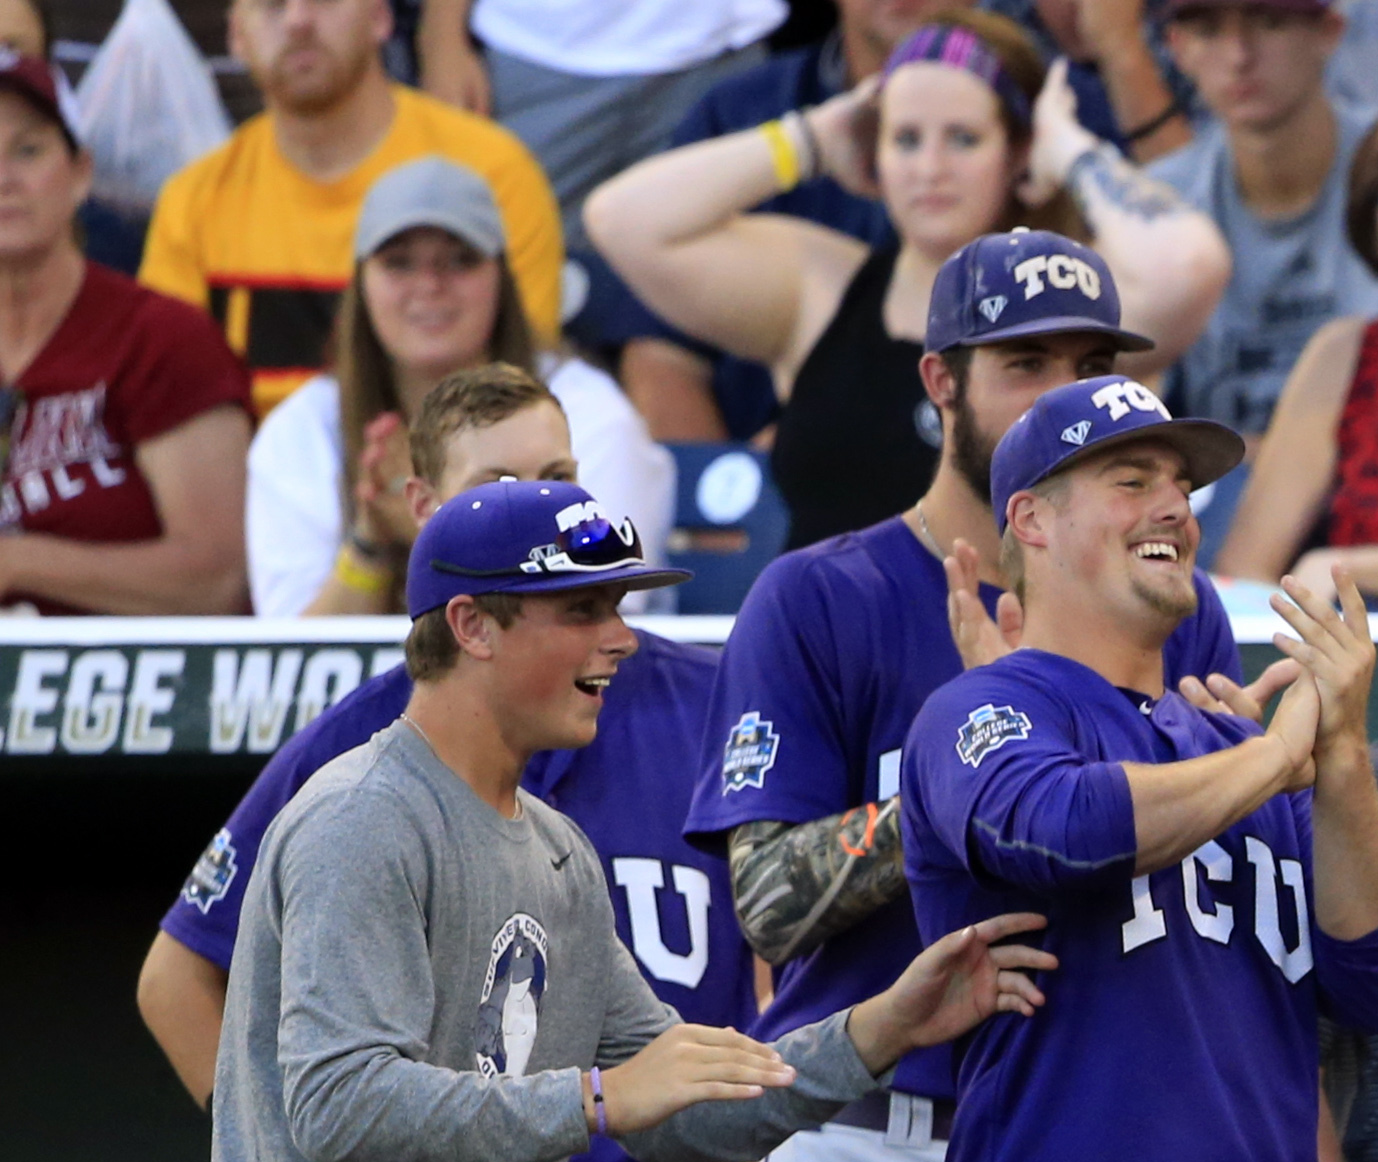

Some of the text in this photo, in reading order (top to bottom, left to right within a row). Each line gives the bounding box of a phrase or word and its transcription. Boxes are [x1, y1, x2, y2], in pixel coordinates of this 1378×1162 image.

[1014, 254, 1101, 301] TCU
[0, 648, 405, 755] EGE WO
[612, 857, 711, 989] U
